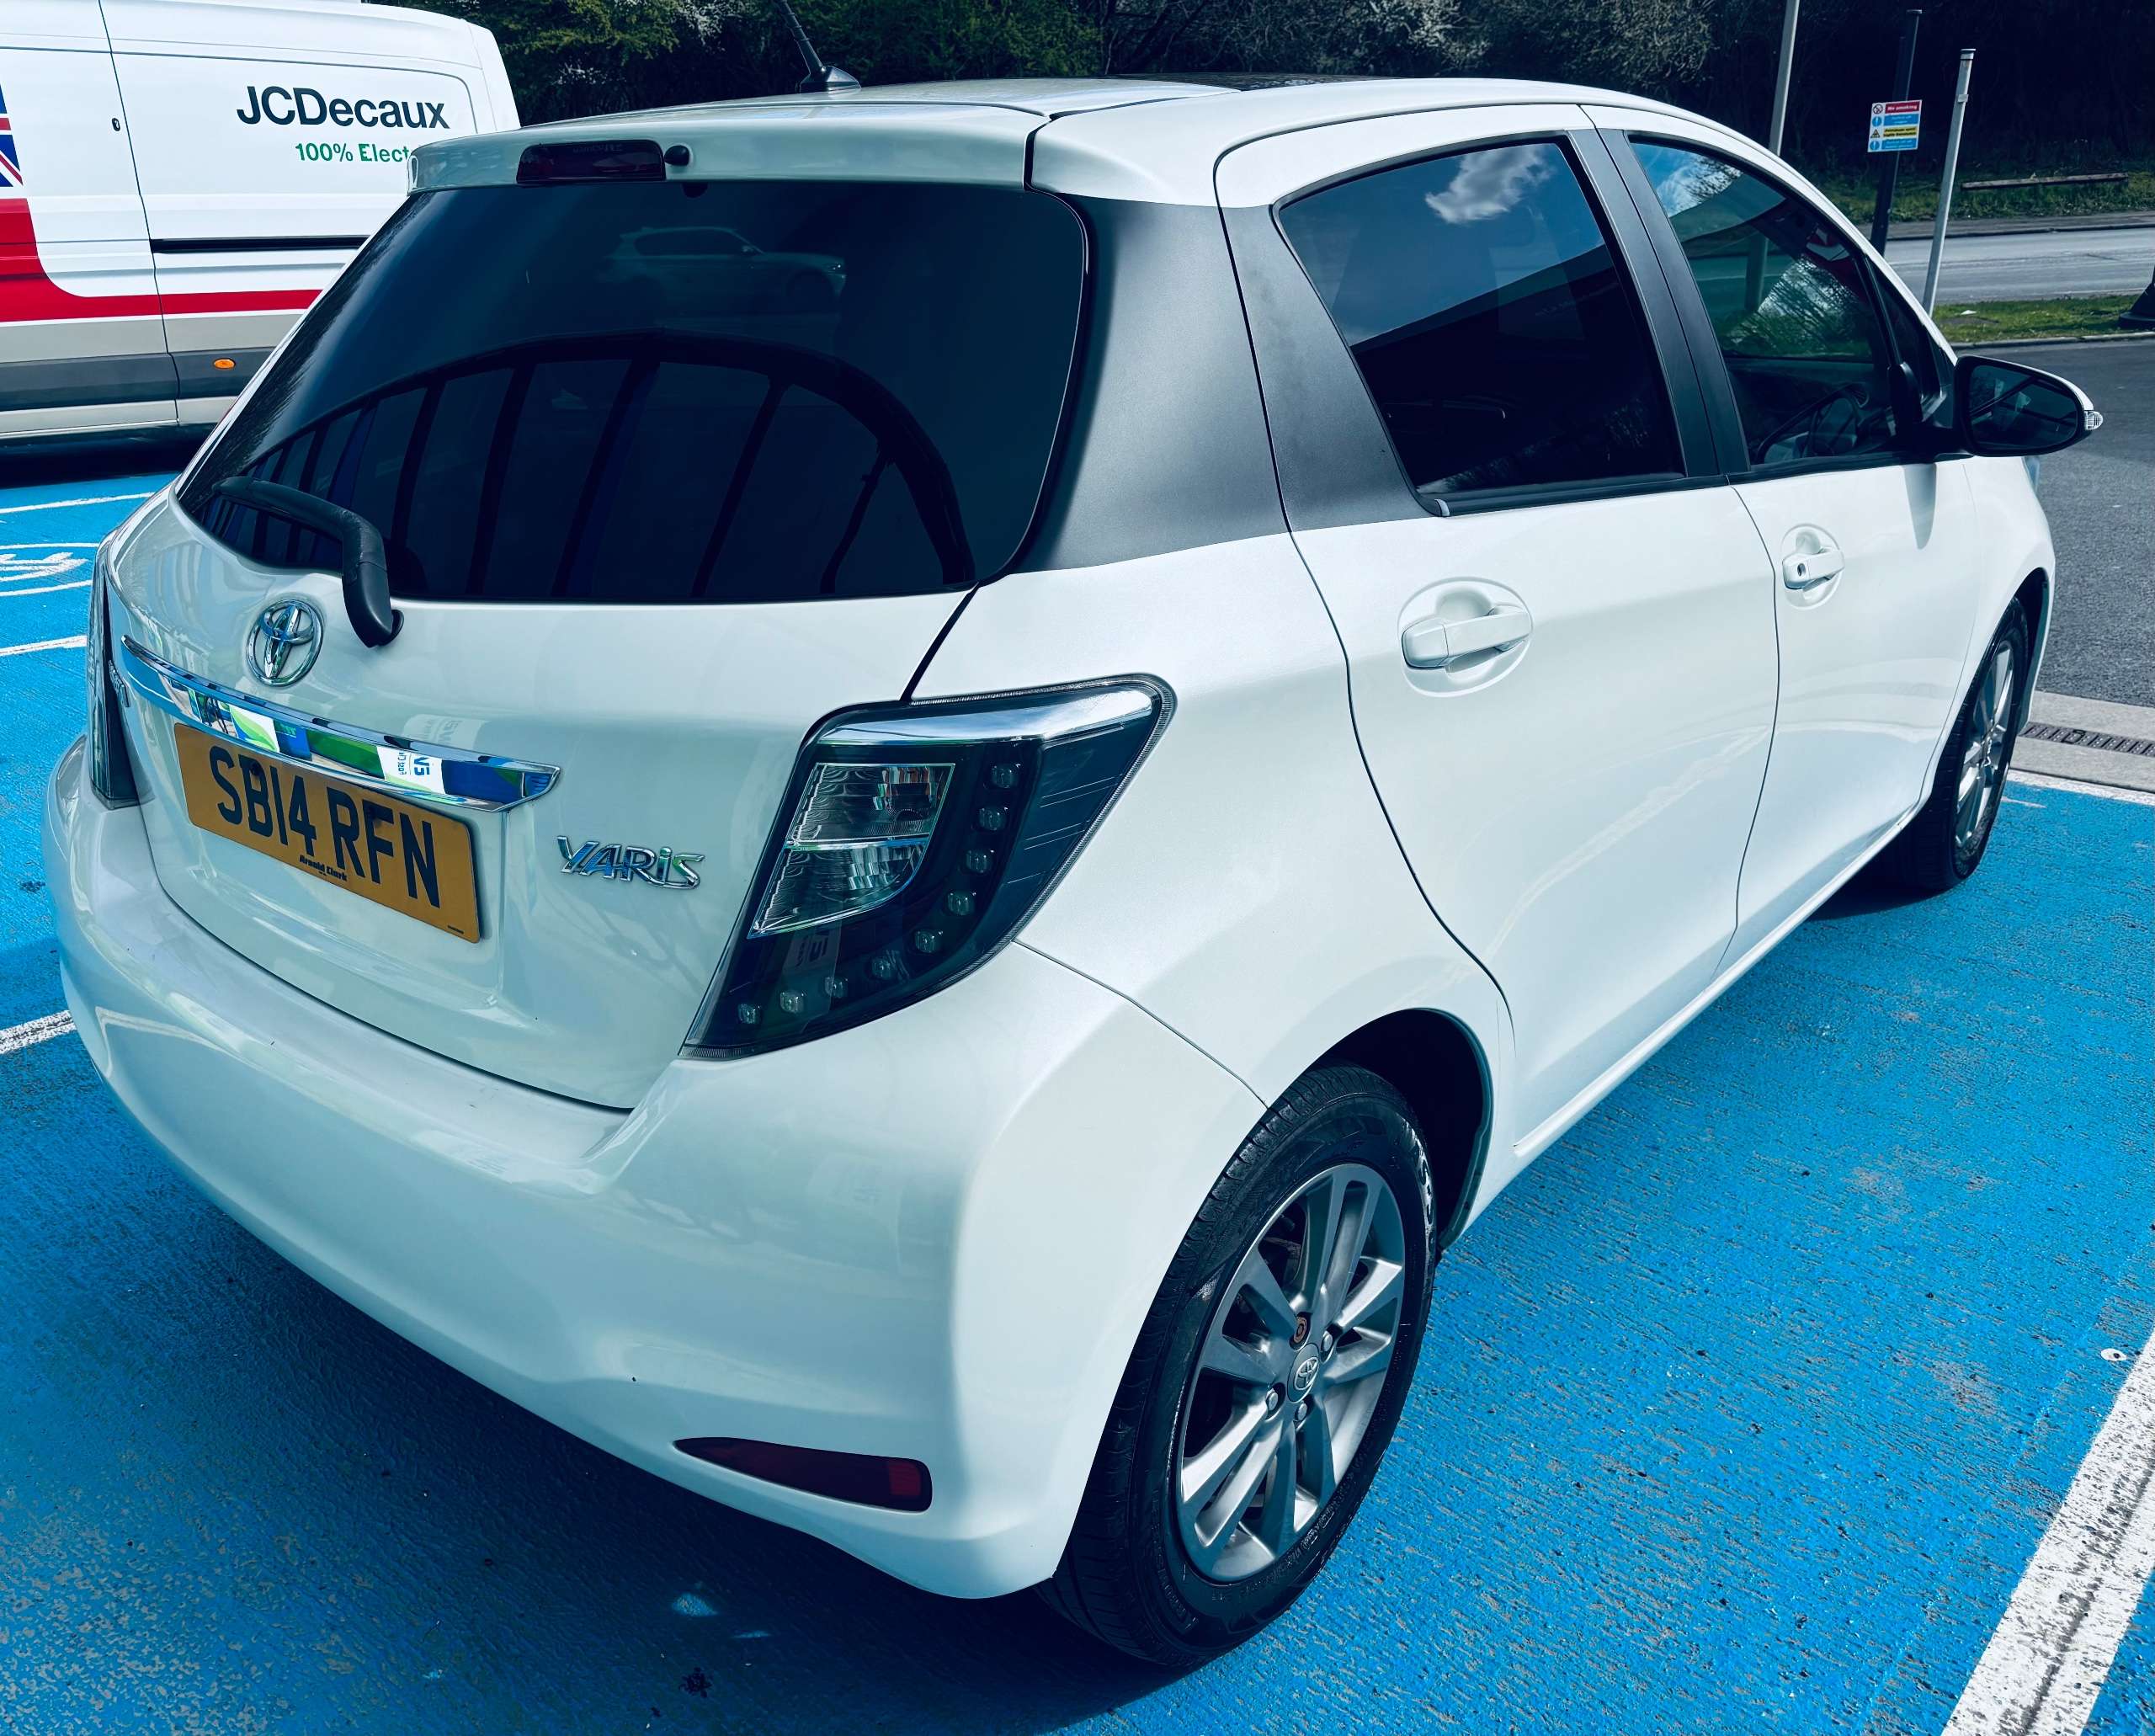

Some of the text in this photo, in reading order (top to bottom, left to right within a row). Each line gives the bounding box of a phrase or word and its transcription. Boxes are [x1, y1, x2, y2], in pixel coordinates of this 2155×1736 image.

[237, 86, 450, 129] JCDecaux
[295, 142, 354, 162] 100%
[210, 745, 440, 909] SB14 RFN
